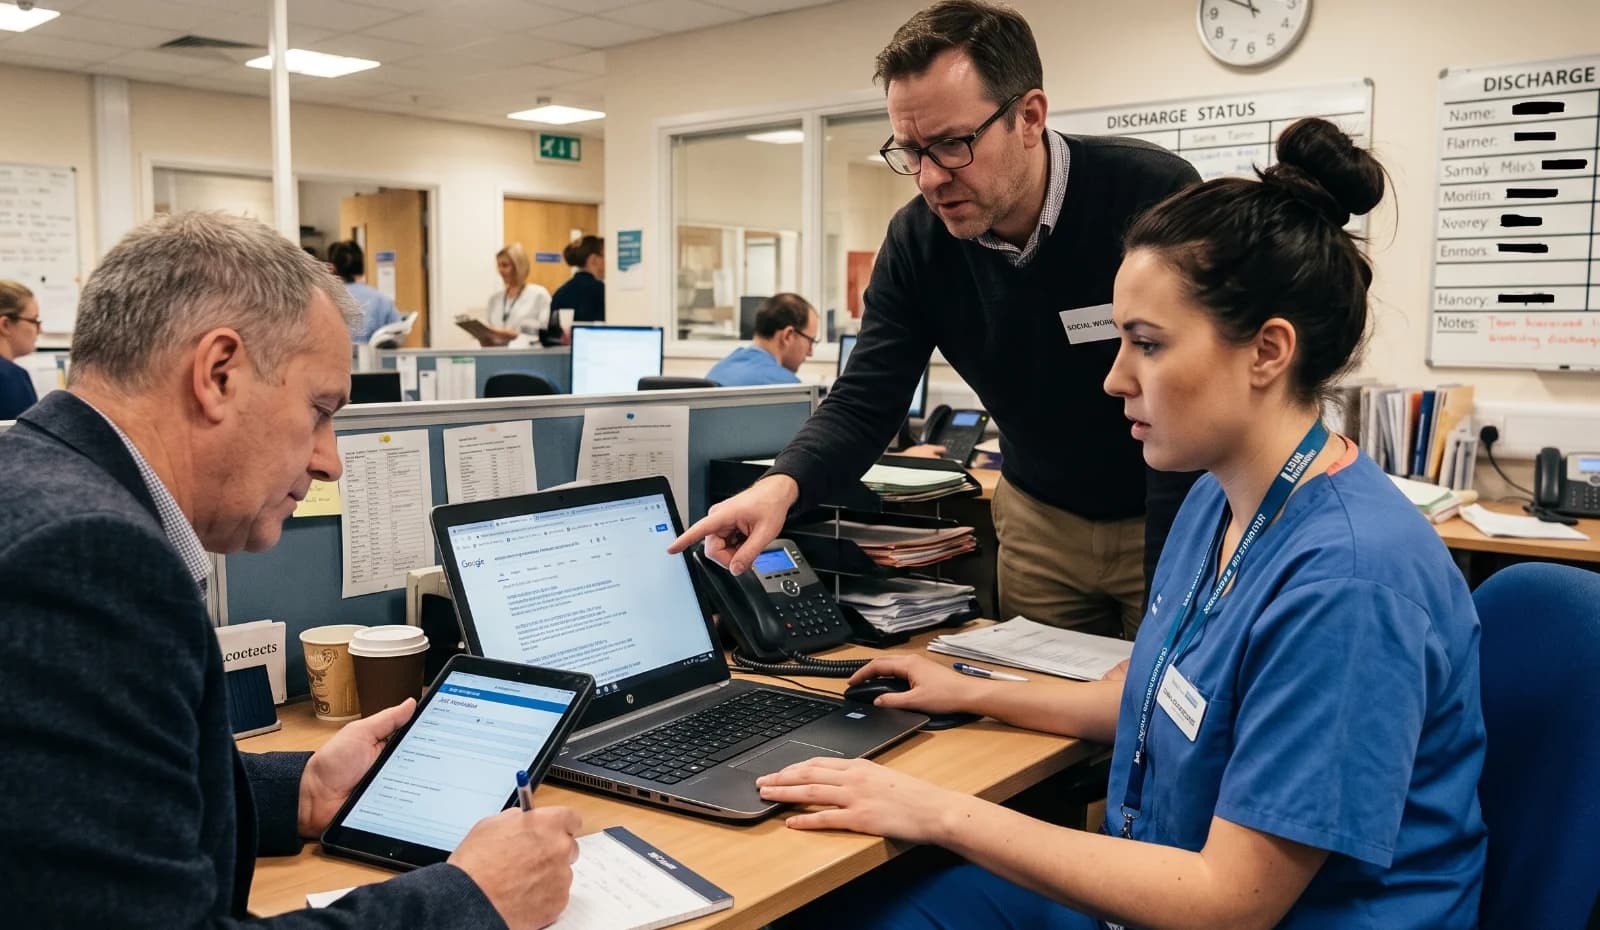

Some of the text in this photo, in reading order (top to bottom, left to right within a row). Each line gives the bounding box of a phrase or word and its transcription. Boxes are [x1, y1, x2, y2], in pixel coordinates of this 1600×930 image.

[1209, 7, 1219, 20] 9
[1281, 17, 1289, 28] 4
[1215, 26, 1224, 39] 8
[1266, 32, 1275, 46] 5
[1230, 38, 1238, 51] 7
[1247, 41, 1255, 54] 6
[1484, 66, 1596, 92] DISCHARGE
[1107, 102, 1256, 129] DISCHARGE STATUS
[1067, 322, 1092, 331] SOCIAL
